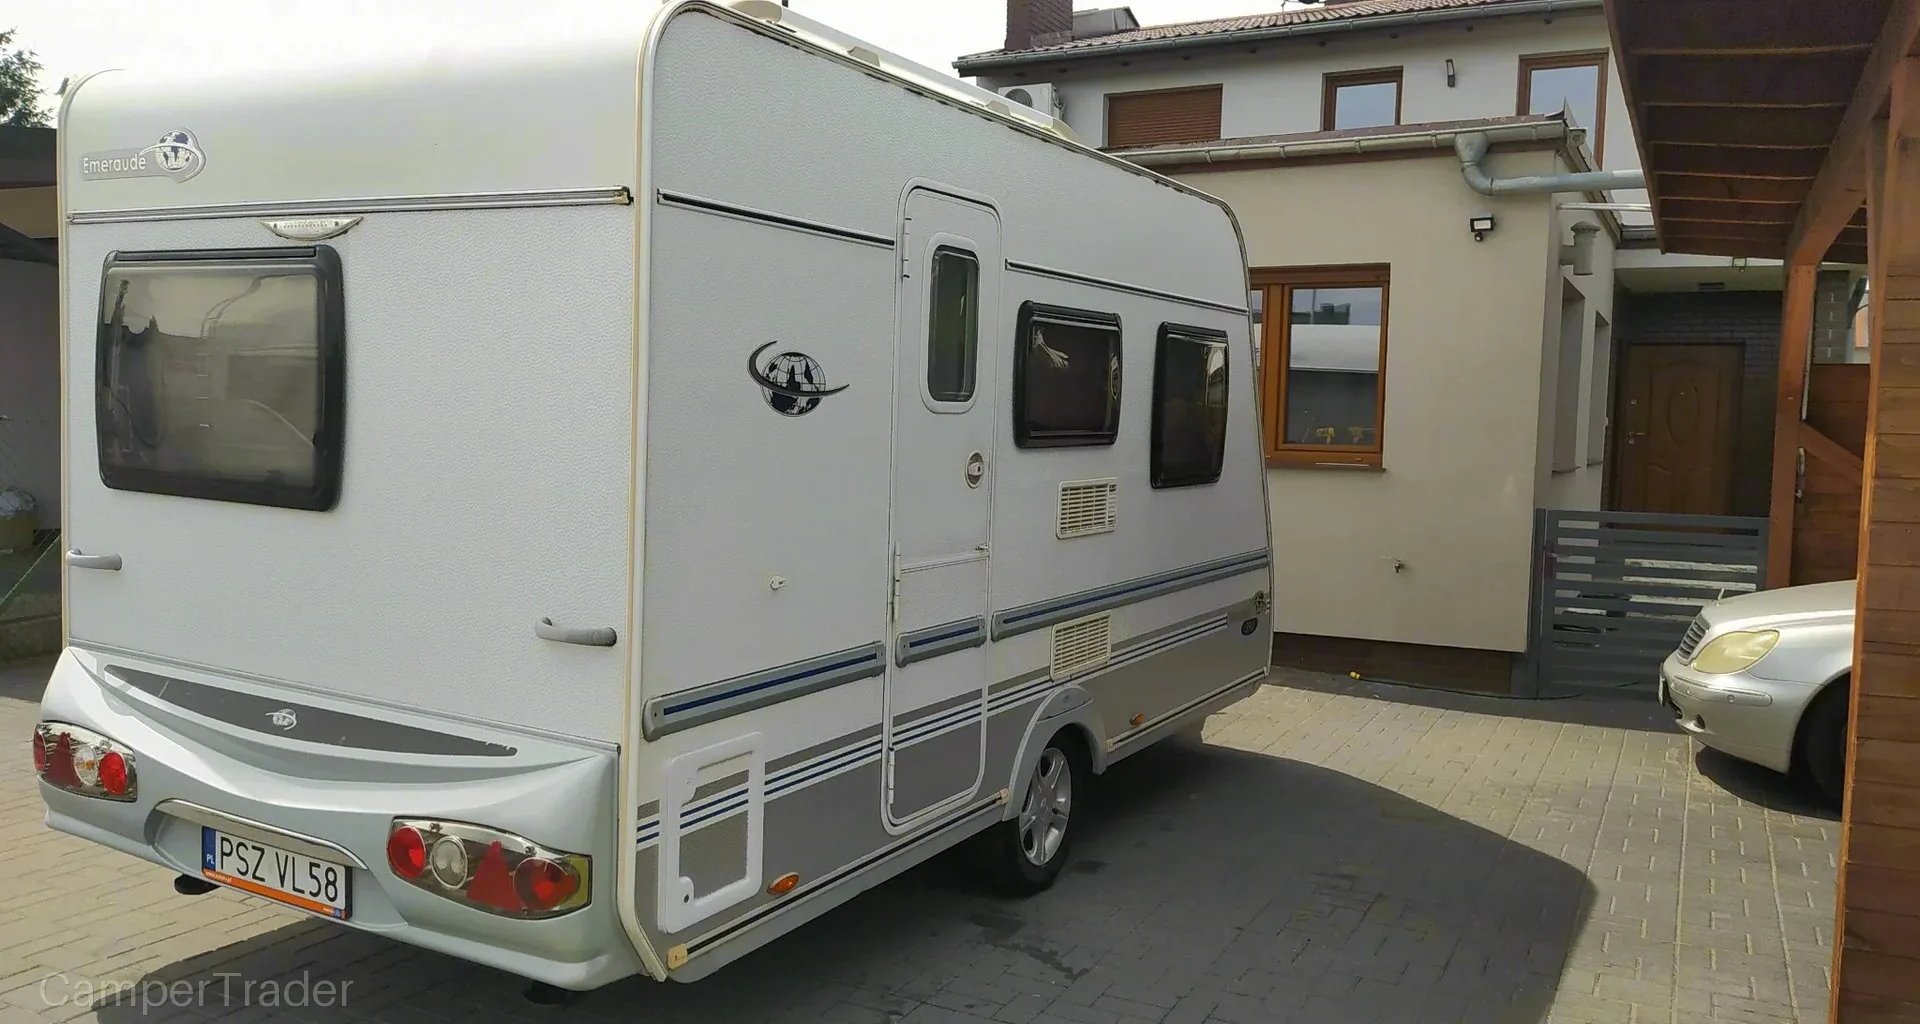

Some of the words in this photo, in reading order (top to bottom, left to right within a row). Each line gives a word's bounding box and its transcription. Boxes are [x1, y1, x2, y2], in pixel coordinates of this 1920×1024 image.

[83, 153, 146, 174] Emeraude
[206, 853, 215, 865] PL
[220, 836, 266, 882] PSZ
[275, 851, 338, 902] VL58
